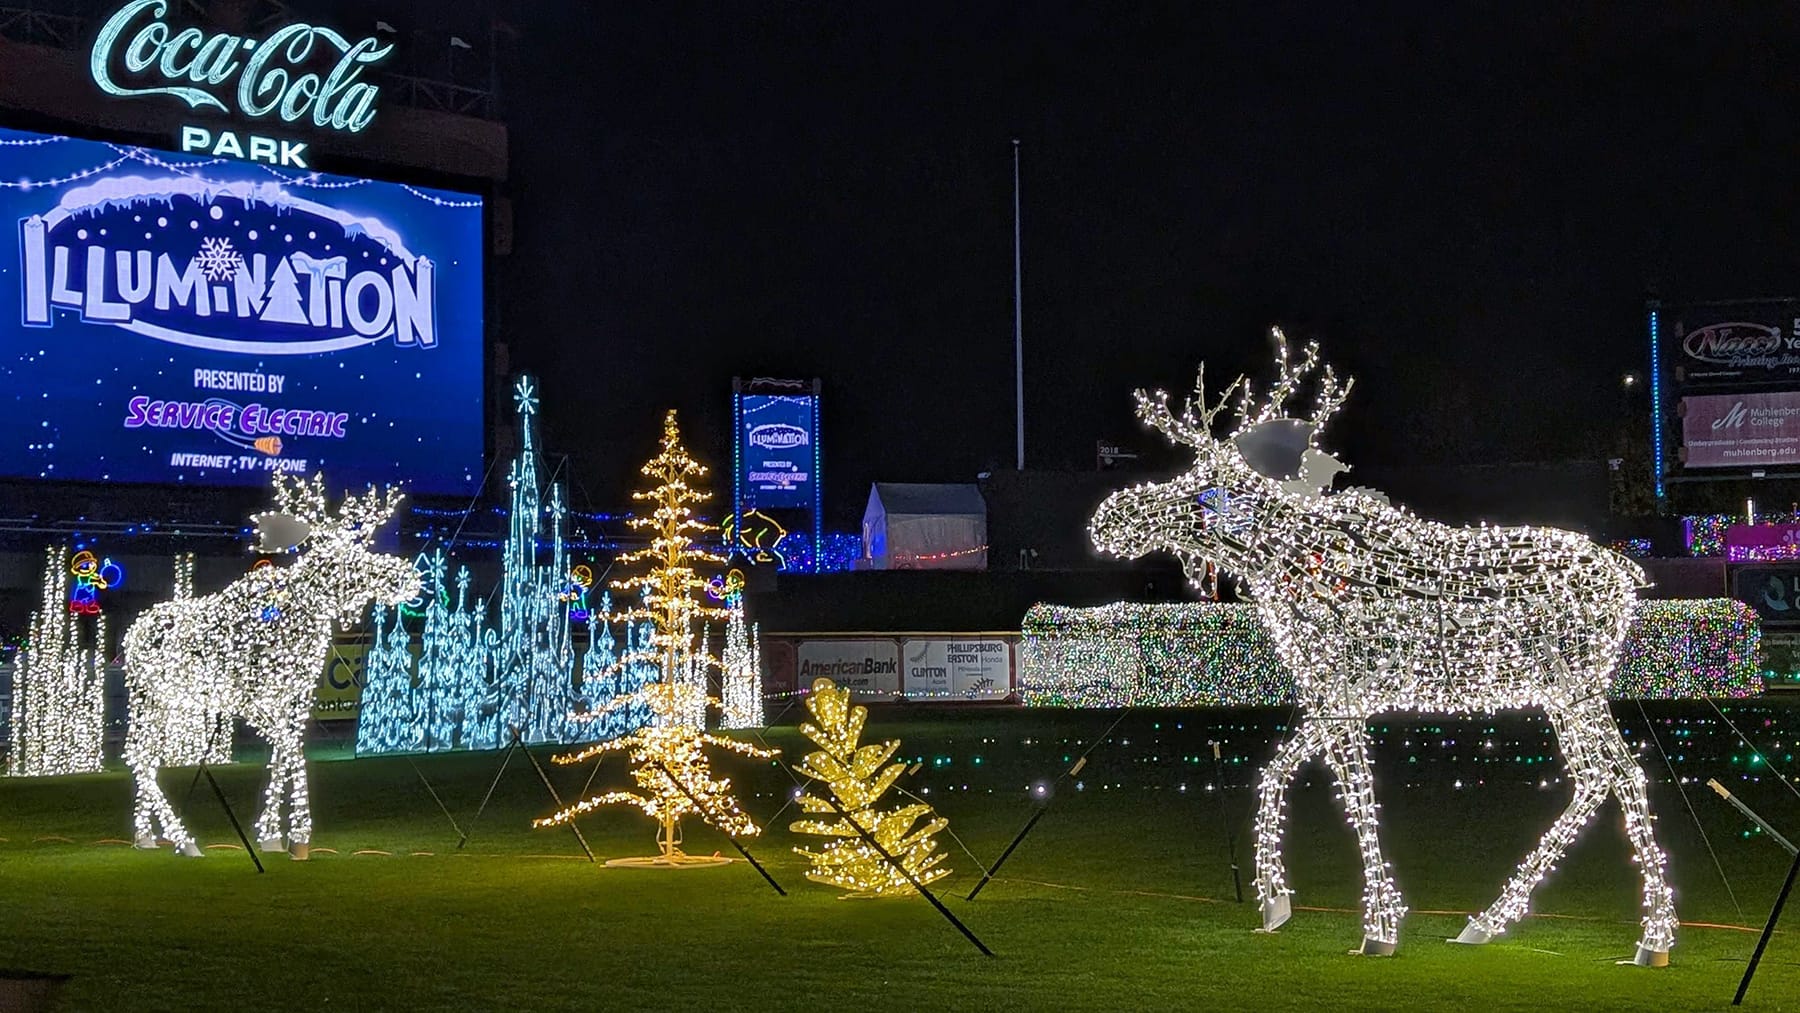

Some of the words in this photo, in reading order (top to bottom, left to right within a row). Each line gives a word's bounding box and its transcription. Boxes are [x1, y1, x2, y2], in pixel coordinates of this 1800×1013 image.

[182, 126, 308, 168] PARK
[194, 369, 266, 393] PRESENTED
[268, 374, 285, 393] BY
[124, 396, 235, 430] SERVICE
[239, 403, 348, 438] ELECTRIC
[1750, 407, 1800, 417] Muhlenber
[1750, 417, 1784, 427] College
[1723, 447, 1796, 456] muhlenberg.edu
[171, 453, 232, 468] INTERNET
[239, 456, 257, 469] TV
[264, 458, 307, 471] PHONE
[947, 643, 1002, 653] PHILLIPSBURG
[947, 654, 978, 663] EASTON
[982, 655, 1002, 663] Honda
[911, 667, 946, 678] CLINTON
